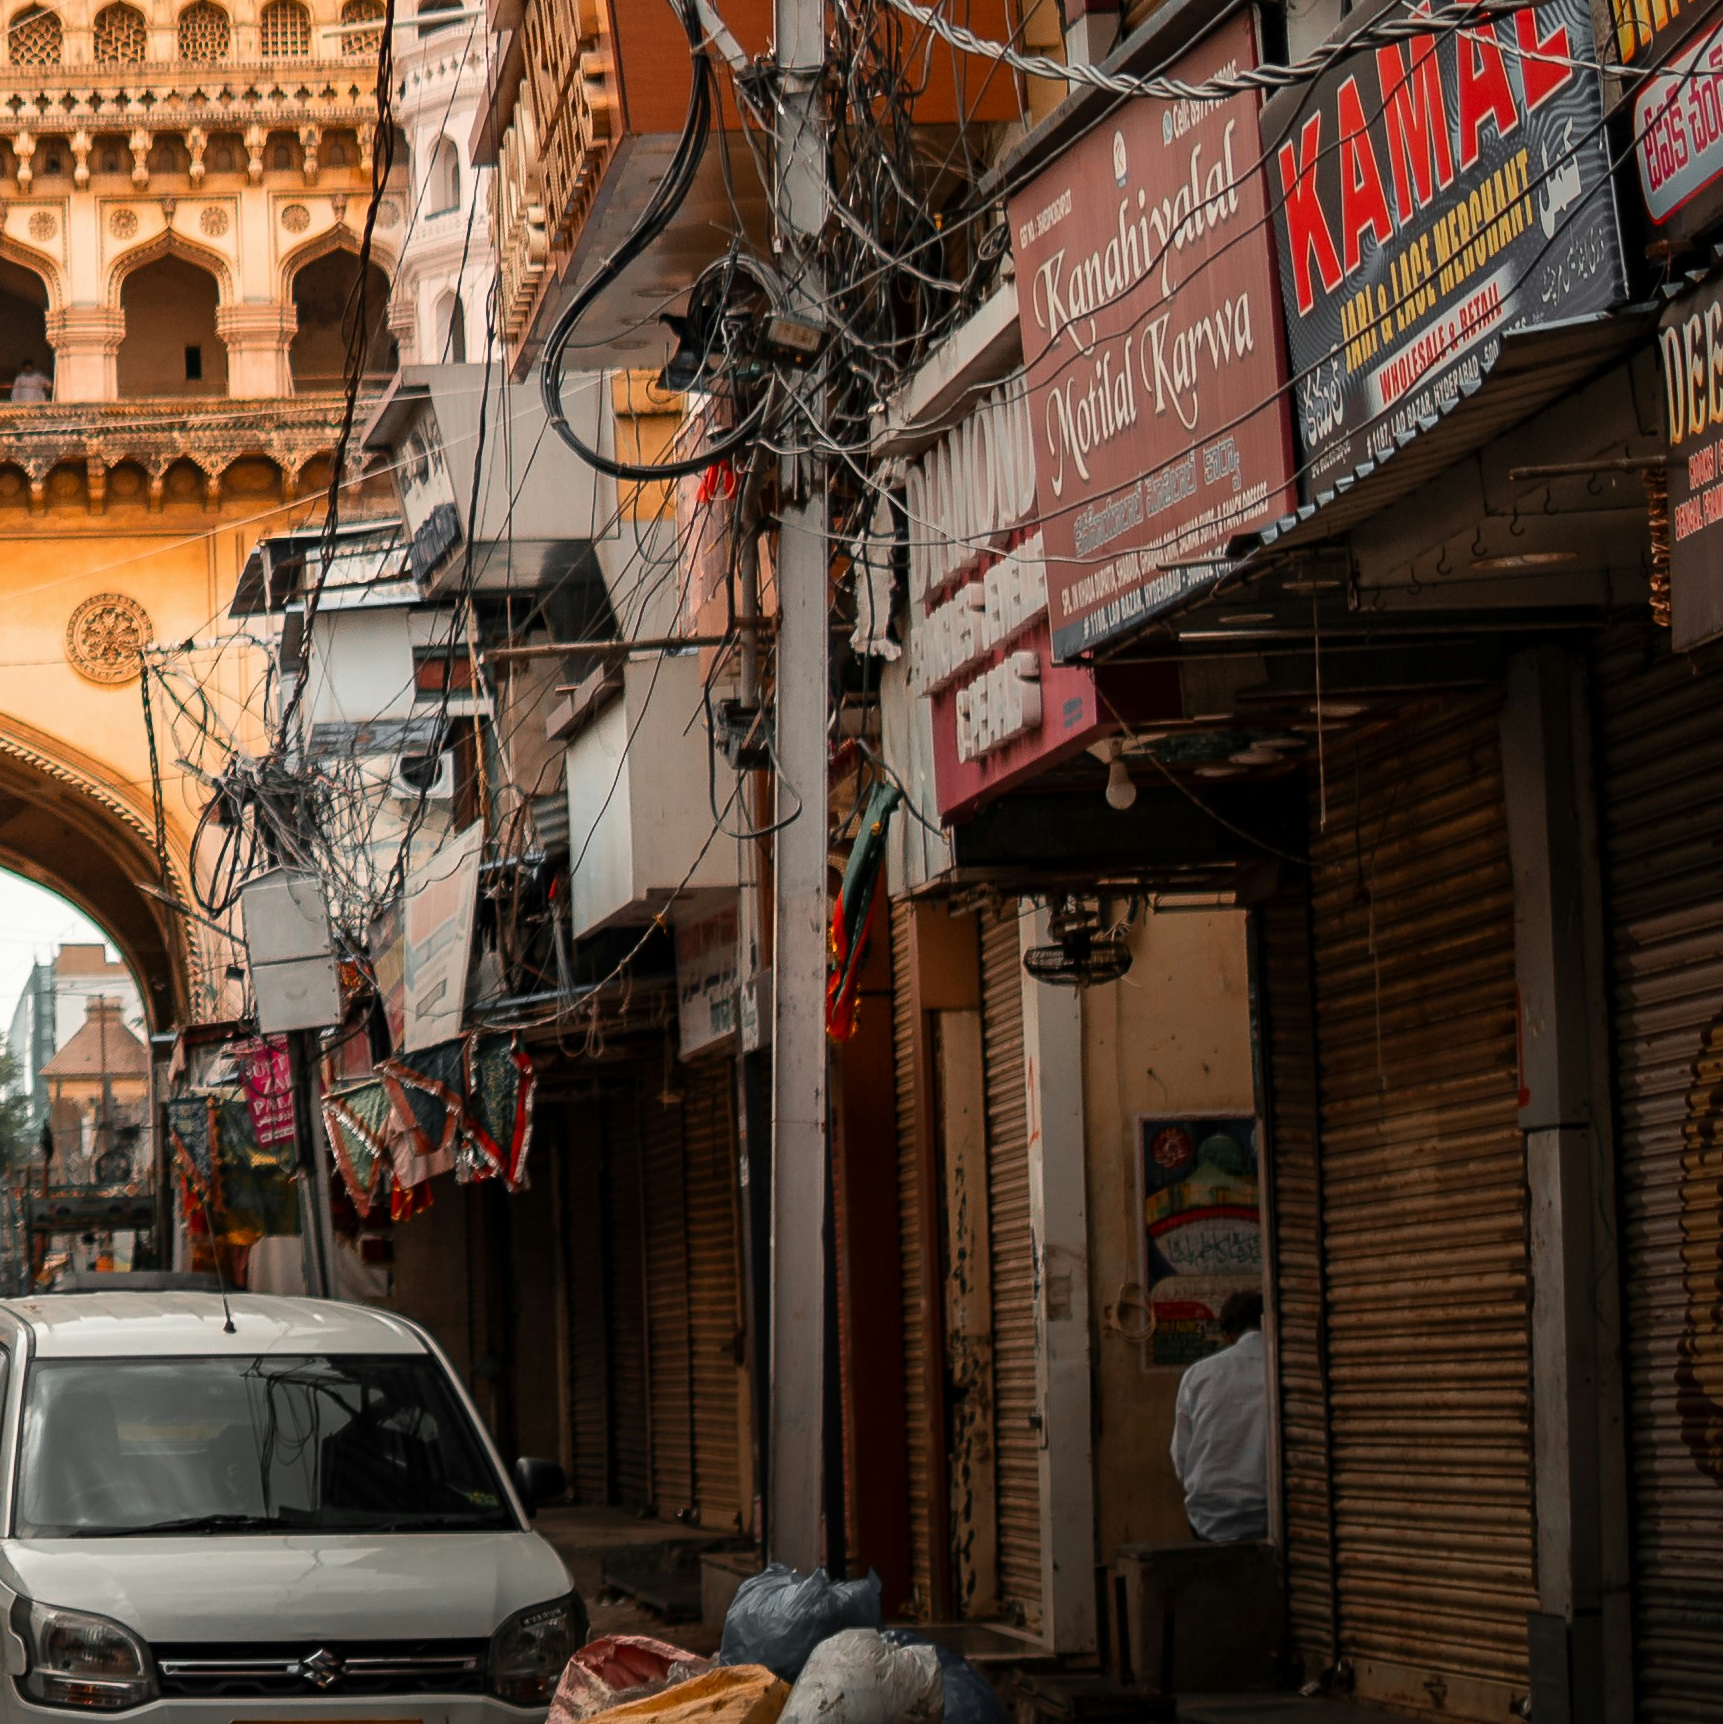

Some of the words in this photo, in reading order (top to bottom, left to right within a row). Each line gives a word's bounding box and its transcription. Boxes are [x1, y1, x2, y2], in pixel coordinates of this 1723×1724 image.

[1390, 233, 1437, 331] LACE
[1432, 147, 1533, 297] MERCHANT
[1046, 335, 1137, 497] Motilal
[1140, 291, 1253, 430] Karwa
[1379, 331, 1447, 404] WHOLESALE
[1459, 282, 1503, 341] RETAIL
